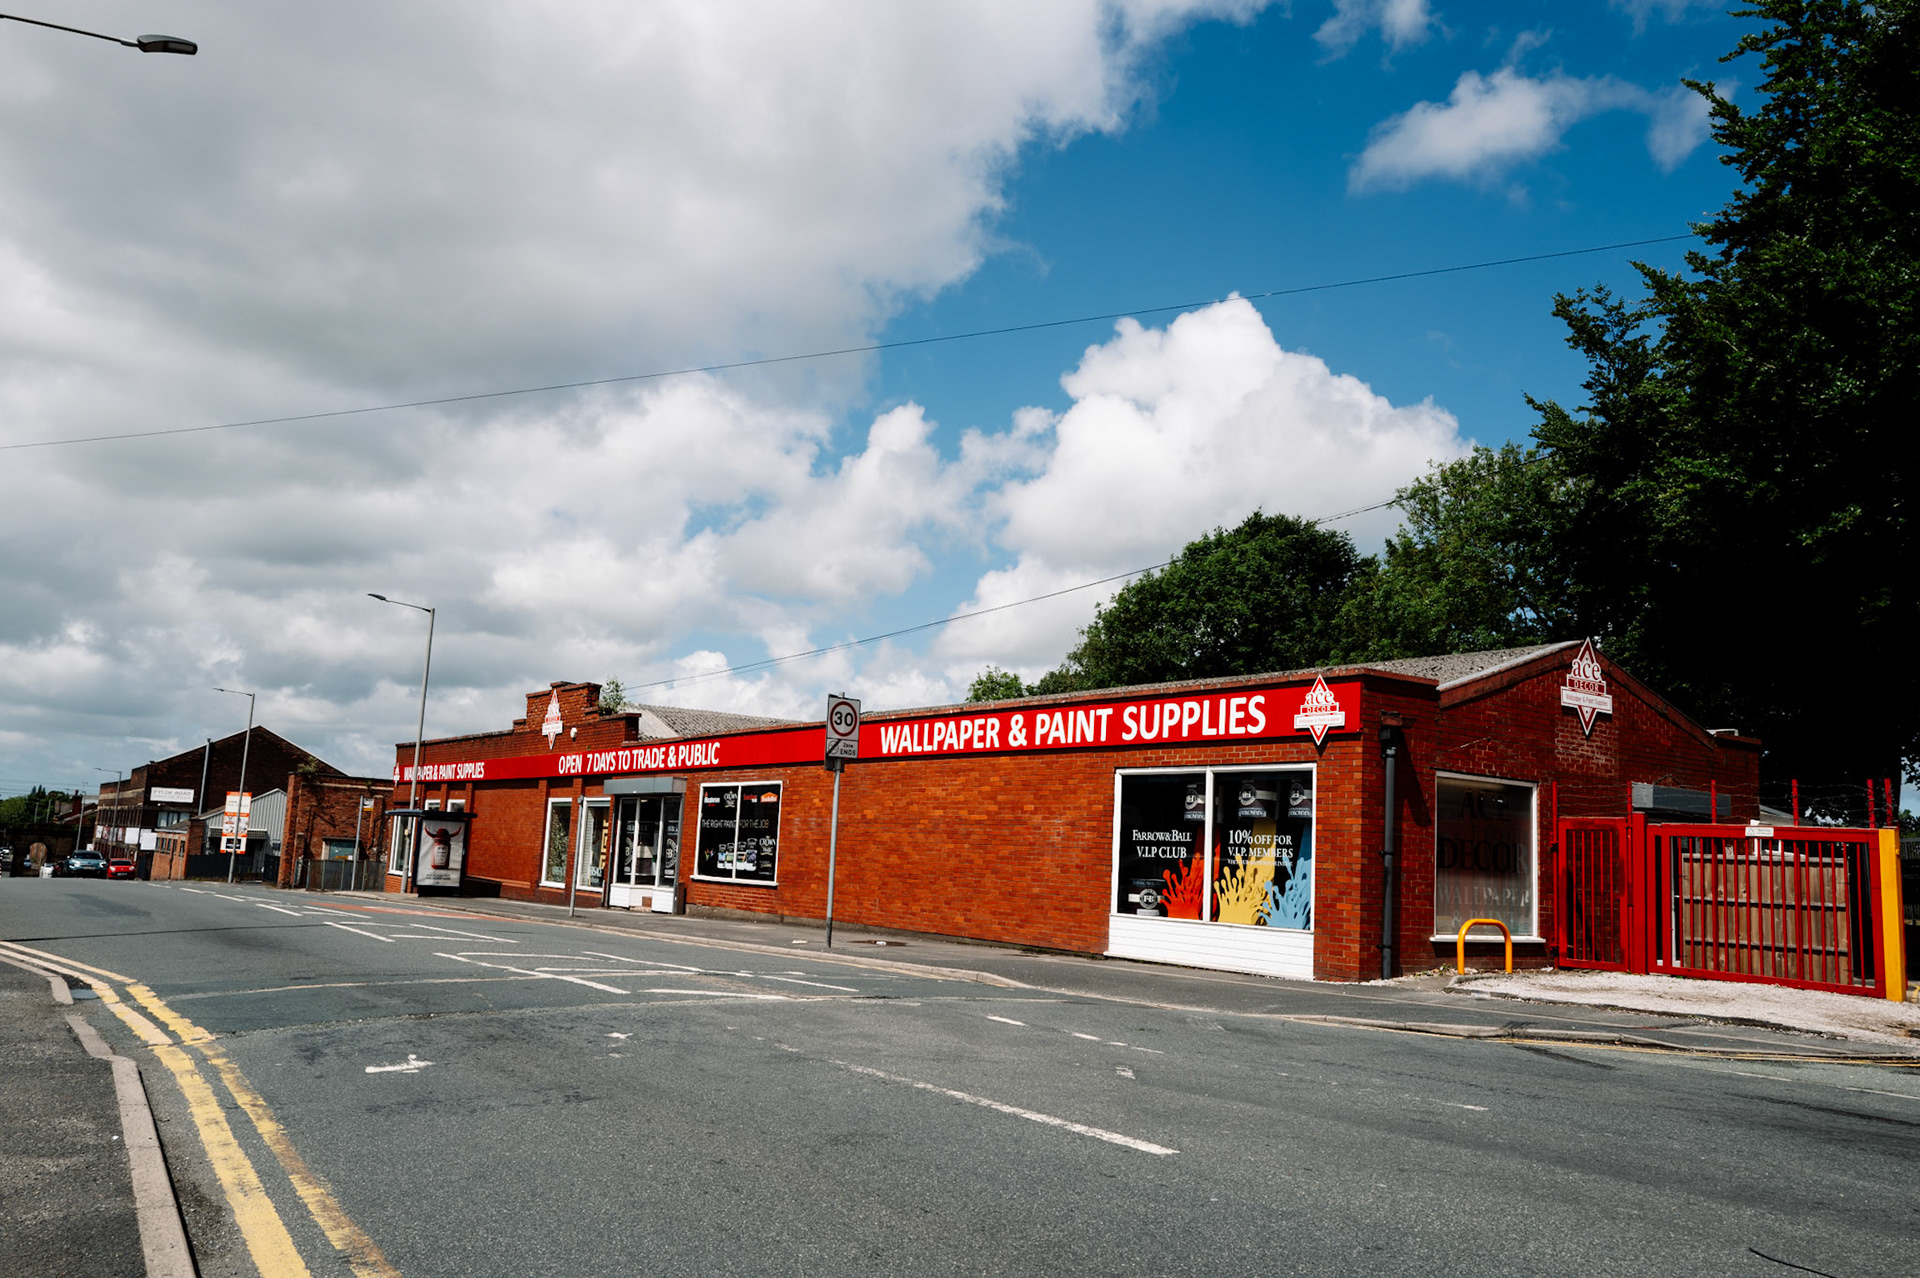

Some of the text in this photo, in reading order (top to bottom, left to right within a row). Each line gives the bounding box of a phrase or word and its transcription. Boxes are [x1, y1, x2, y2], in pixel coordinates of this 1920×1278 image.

[1572, 660, 1600, 681] ace
[1573, 681, 1600, 692] DECOR
[1306, 691, 1333, 705] ace
[1307, 704, 1331, 713] DECOR
[834, 711, 854, 727] 30
[880, 695, 1267, 754] WALLPAPER & PAINT SUPPLIES
[558, 741, 721, 775] OPEN 7 DAYS TO TRADE & PUBLIC
[840, 748, 856, 756] ENDS
[433, 764, 438, 781] &
[439, 763, 457, 780] PAINT
[456, 761, 485, 780] SUPPLIES
[1459, 790, 1511, 821] ACE
[710, 819, 723, 829] RIGHT
[740, 819, 750, 829] FOR
[750, 819, 759, 829] THE
[759, 819, 769, 829] JOB
[1228, 829, 1293, 845] 10% OFF FOR
[1136, 846, 1187, 859] V.I.P CLUB
[1248, 847, 1294, 858] MEMBERS
[1438, 837, 1530, 874] DECOR
[1437, 884, 1530, 907] WALLPAPER
[1451, 909, 1516, 929] & PAINT
